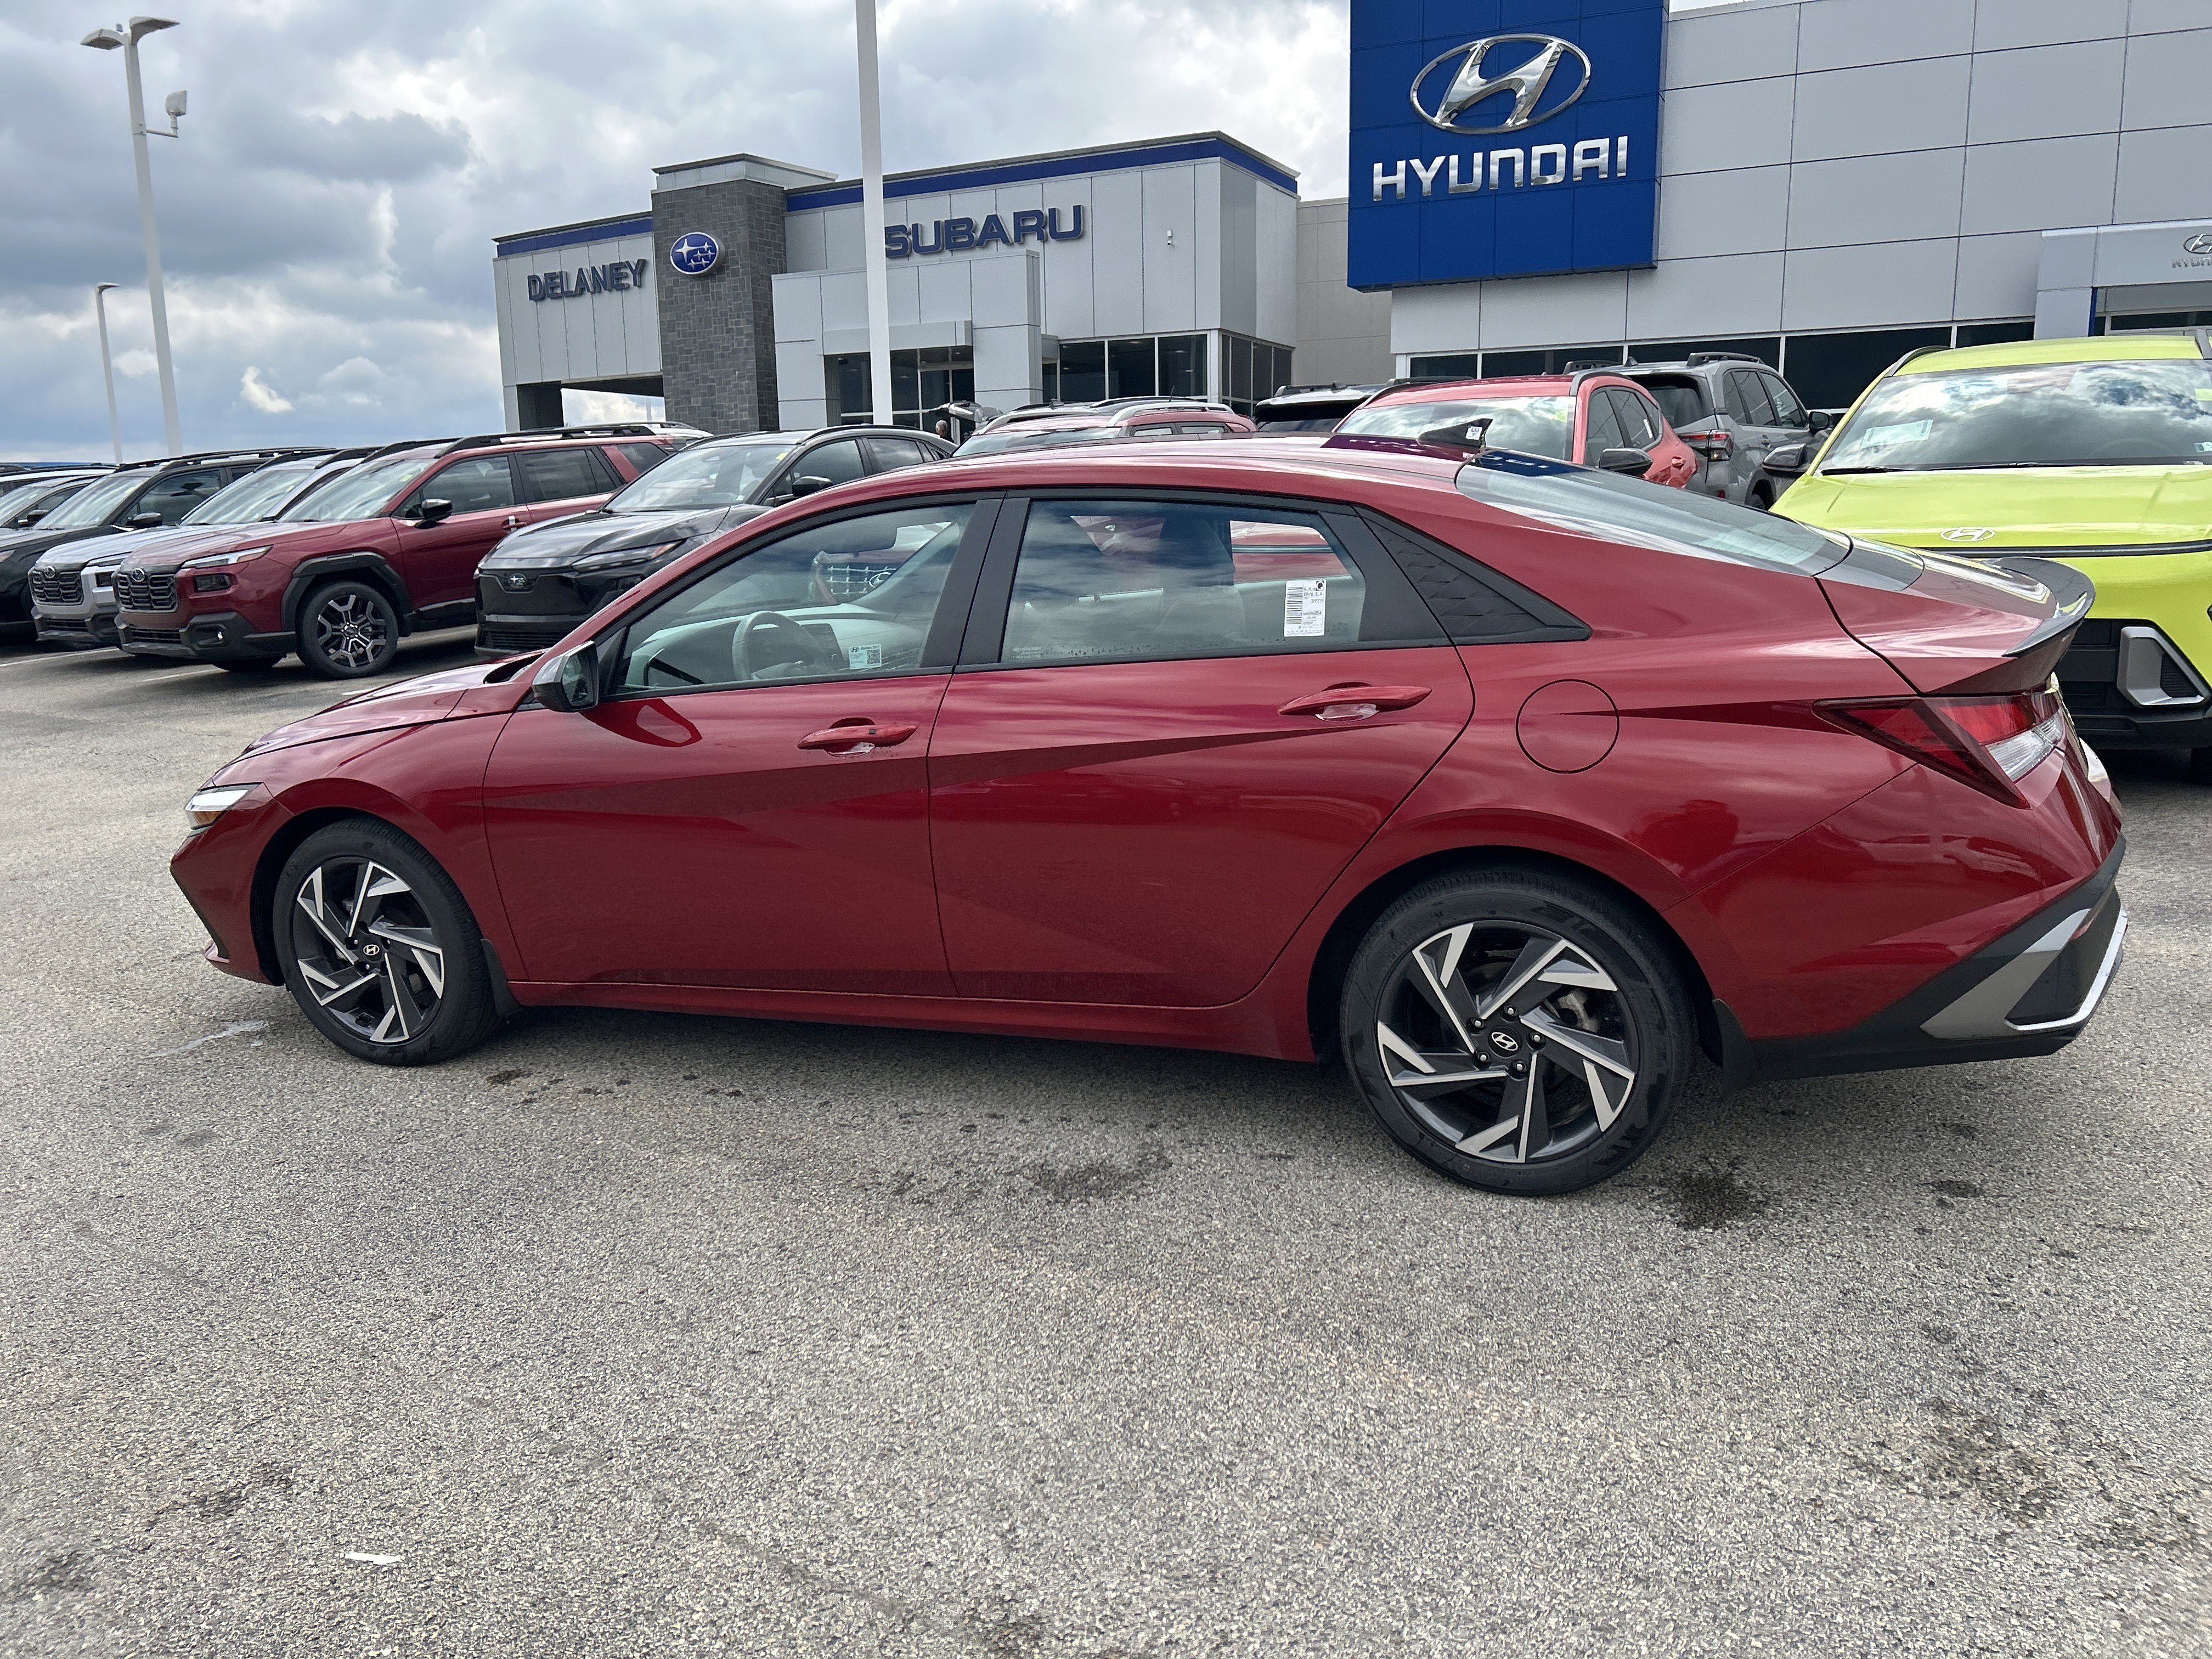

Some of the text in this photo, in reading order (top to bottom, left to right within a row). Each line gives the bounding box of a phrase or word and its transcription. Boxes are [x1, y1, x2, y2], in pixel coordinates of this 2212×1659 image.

[1372, 136, 1628, 202] HYUNDAI
[884, 204, 1085, 258] SUBARU
[527, 258, 647, 301] DELANEY
[2172, 257, 2212, 268] HYUN
